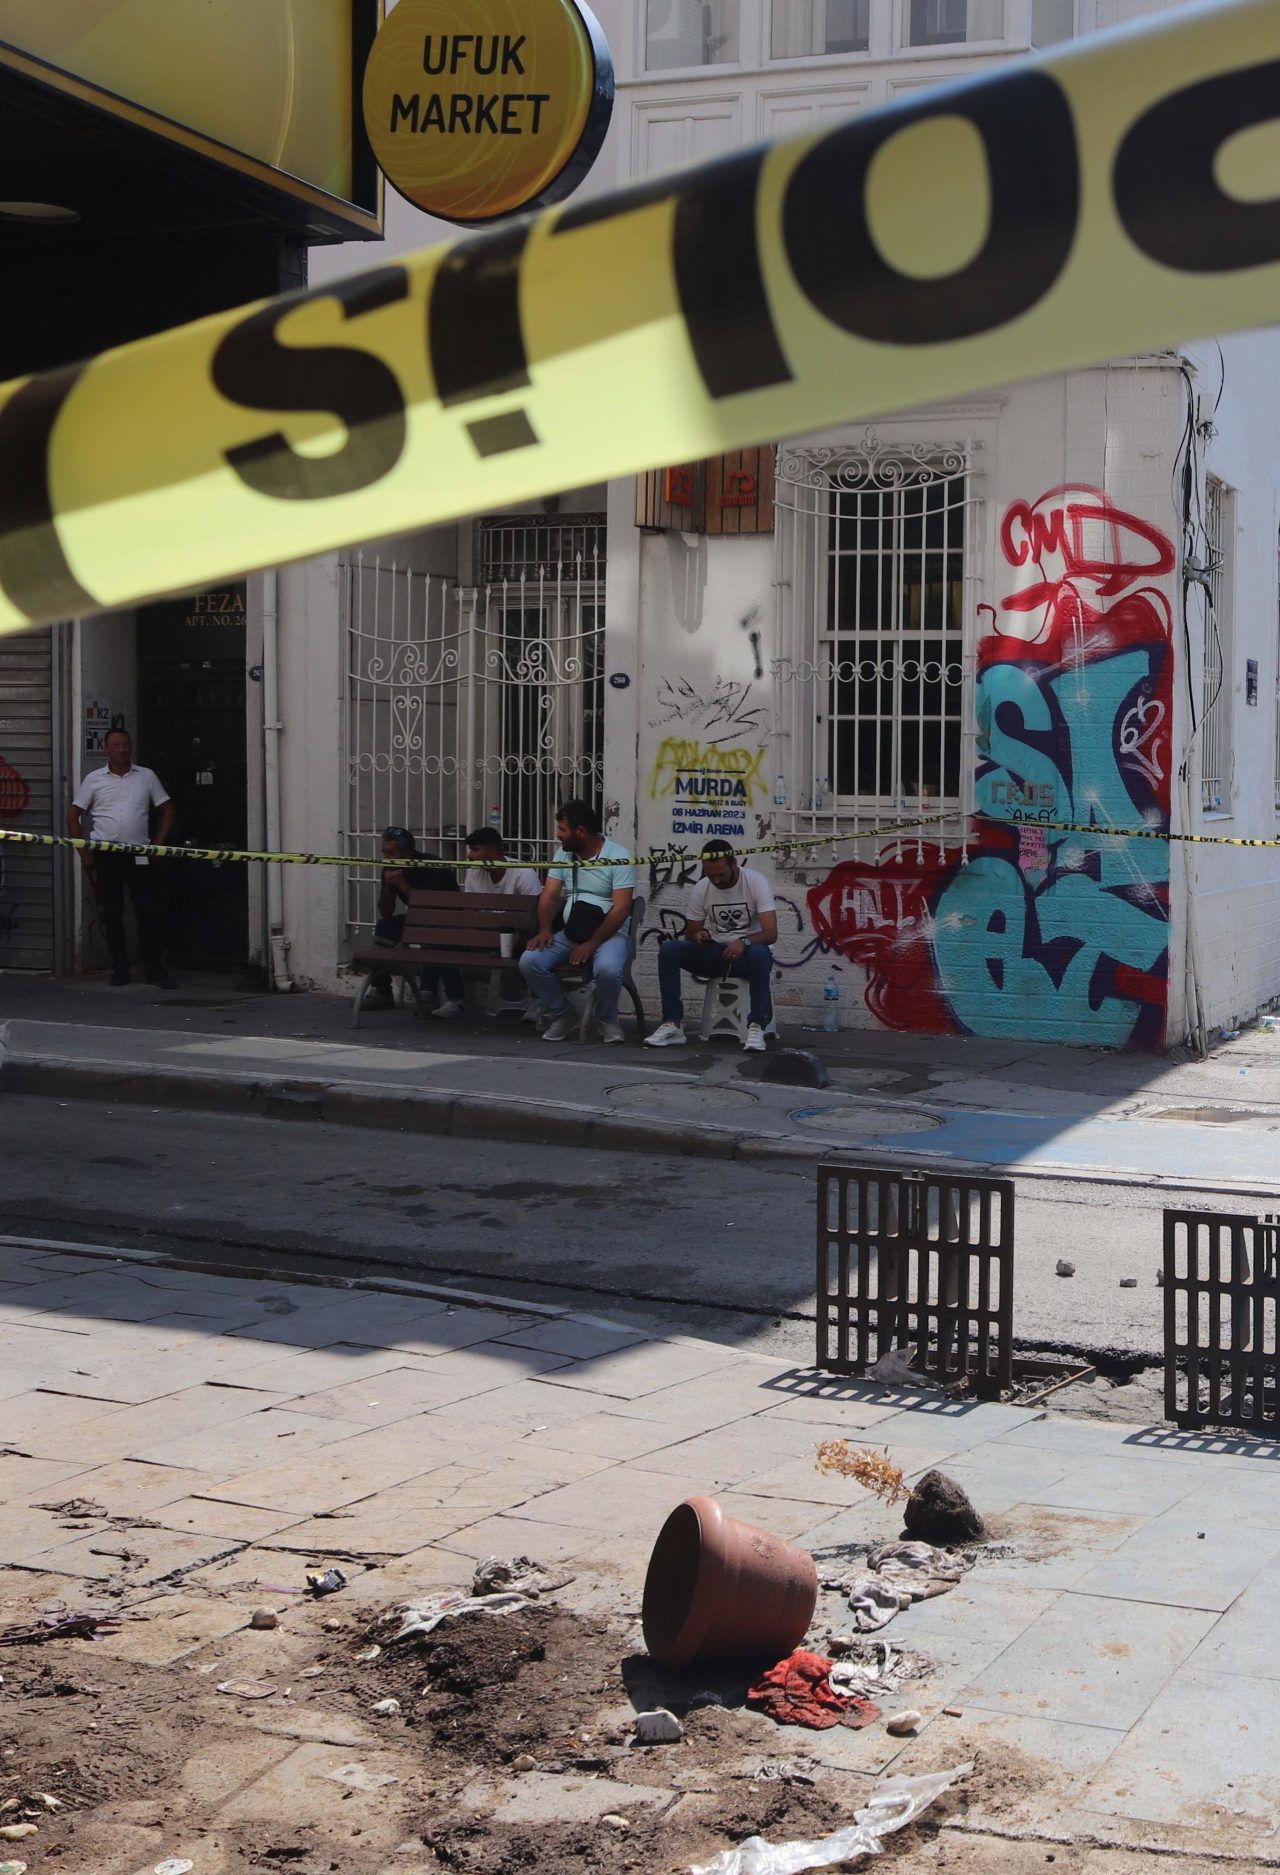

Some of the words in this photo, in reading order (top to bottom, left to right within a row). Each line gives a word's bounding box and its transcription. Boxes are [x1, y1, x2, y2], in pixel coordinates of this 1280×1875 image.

[423, 34, 526, 76] UFUK
[389, 93, 550, 136] MARKET
[193, 593, 245, 613] FEZA
[675, 777, 747, 798] MURDA
[685, 807, 722, 818] HAZİRAN
[672, 819, 703, 835] İZMİR
[706, 823, 745, 836] ARENA
